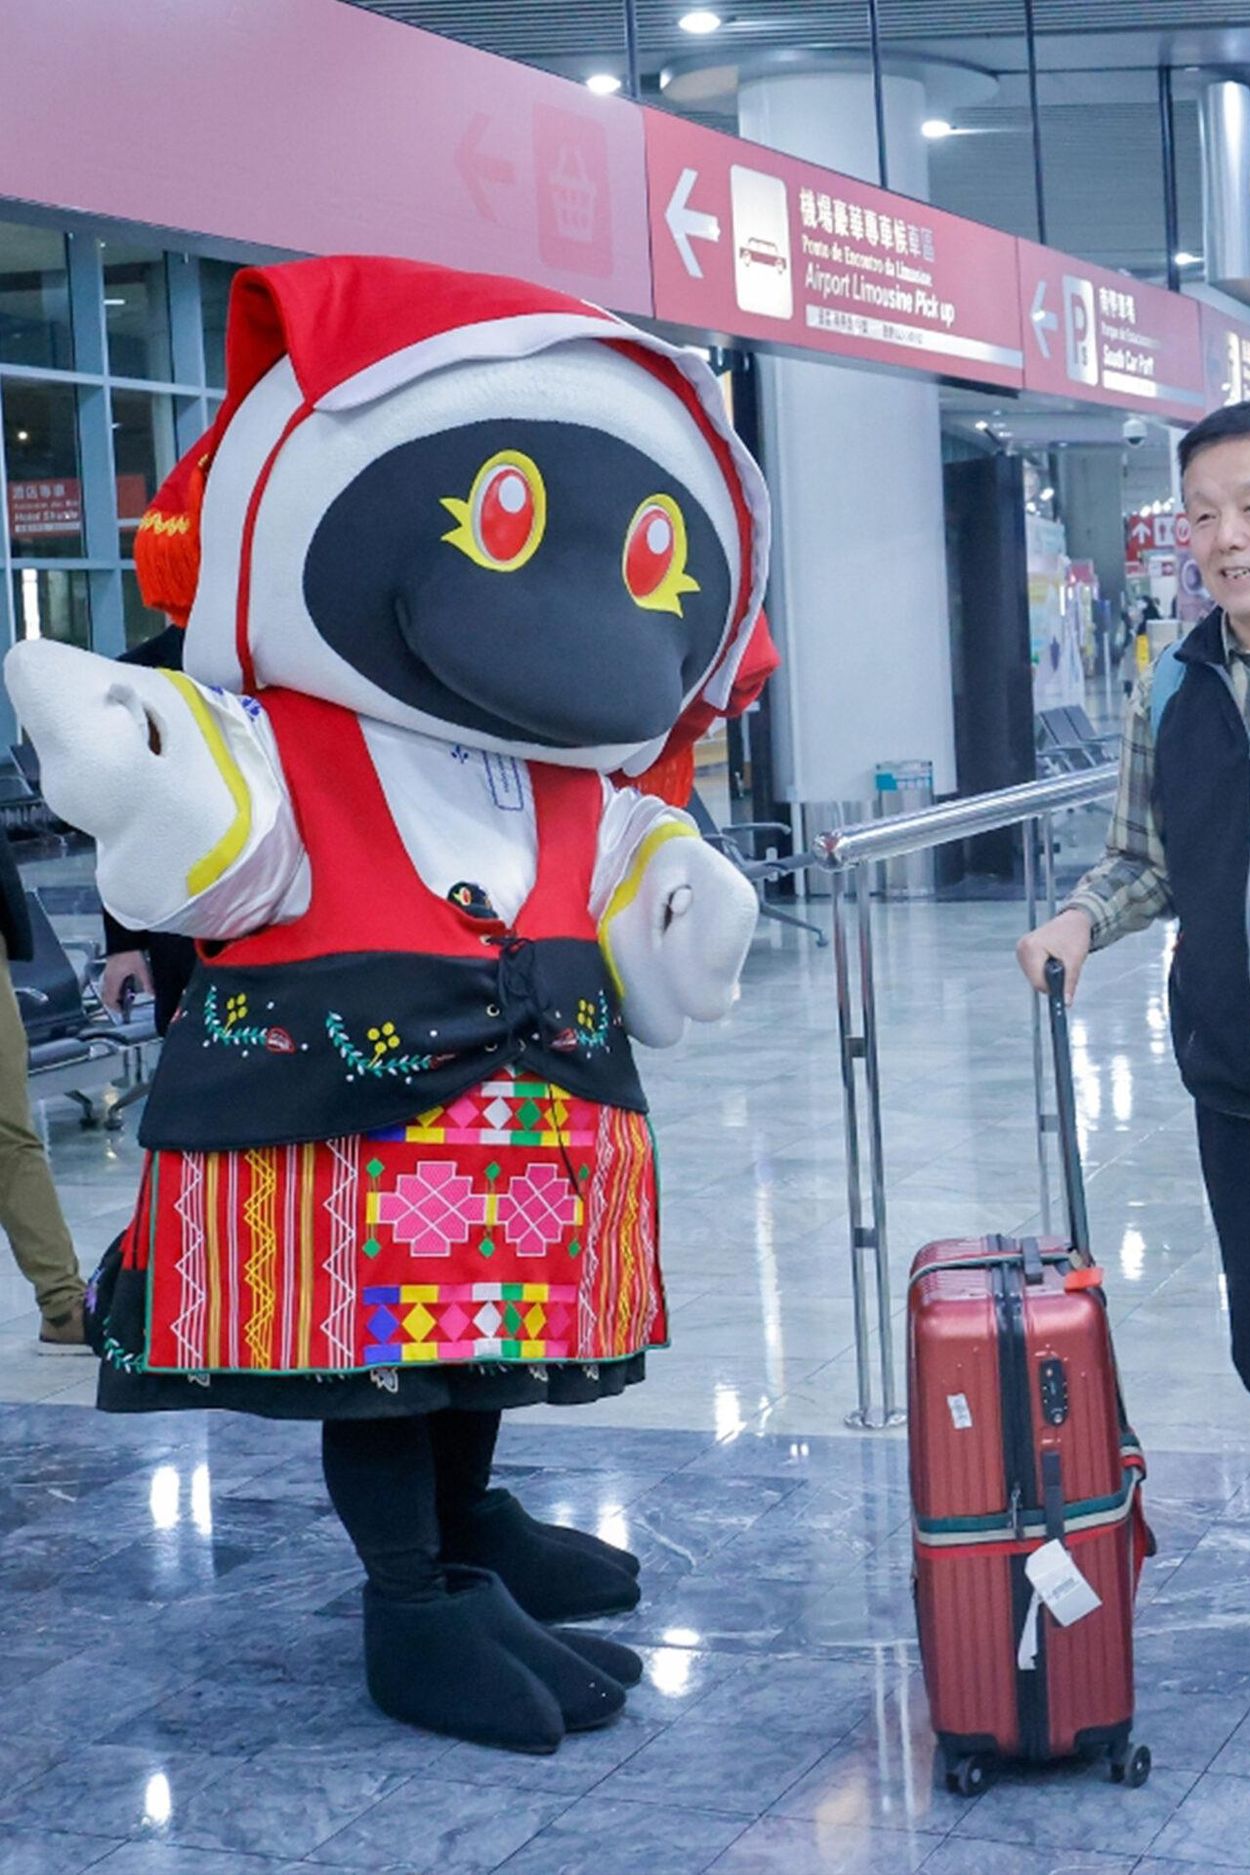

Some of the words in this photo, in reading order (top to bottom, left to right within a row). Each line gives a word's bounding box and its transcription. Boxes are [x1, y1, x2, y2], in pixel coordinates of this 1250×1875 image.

[805, 262, 850, 299] Airport
[852, 273, 913, 313] Limousine
[915, 290, 940, 319] Pick
[940, 302, 956, 327] up
